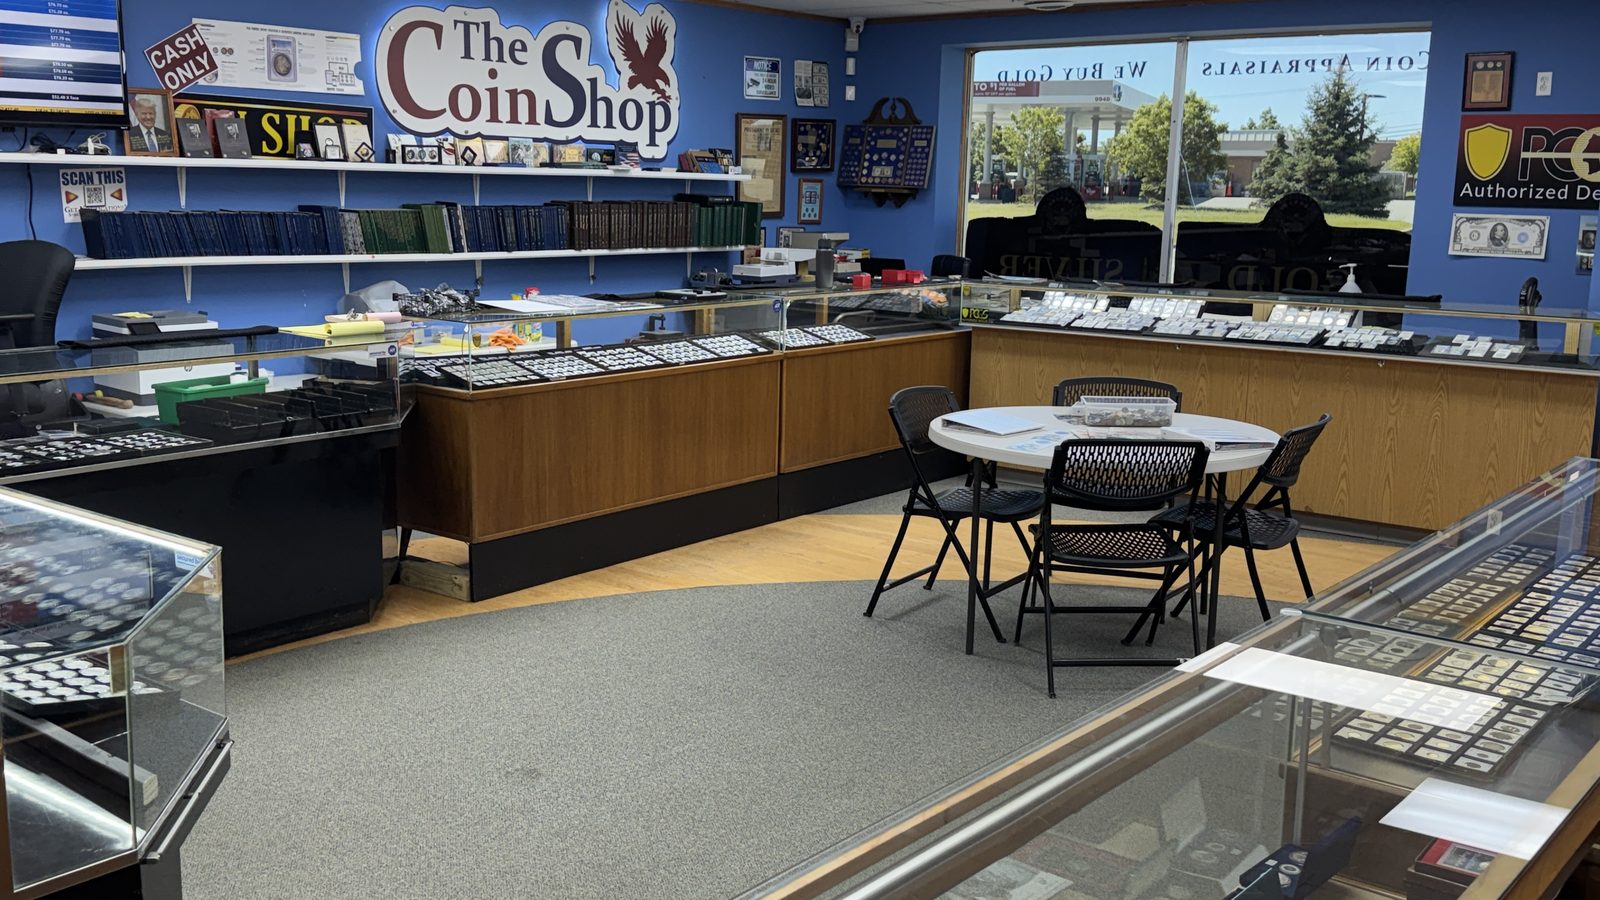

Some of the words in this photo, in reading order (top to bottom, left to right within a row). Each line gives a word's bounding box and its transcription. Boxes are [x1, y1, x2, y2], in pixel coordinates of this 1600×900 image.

[150, 28, 204, 69] CASH
[454, 20, 528, 66] The
[164, 52, 210, 90] ONLY
[387, 20, 541, 126] Coin
[542, 34, 672, 147] Shop
[61, 171, 94, 186] SCAN
[96, 170, 124, 184] THIS
[1460, 182, 1568, 199] Authorized
